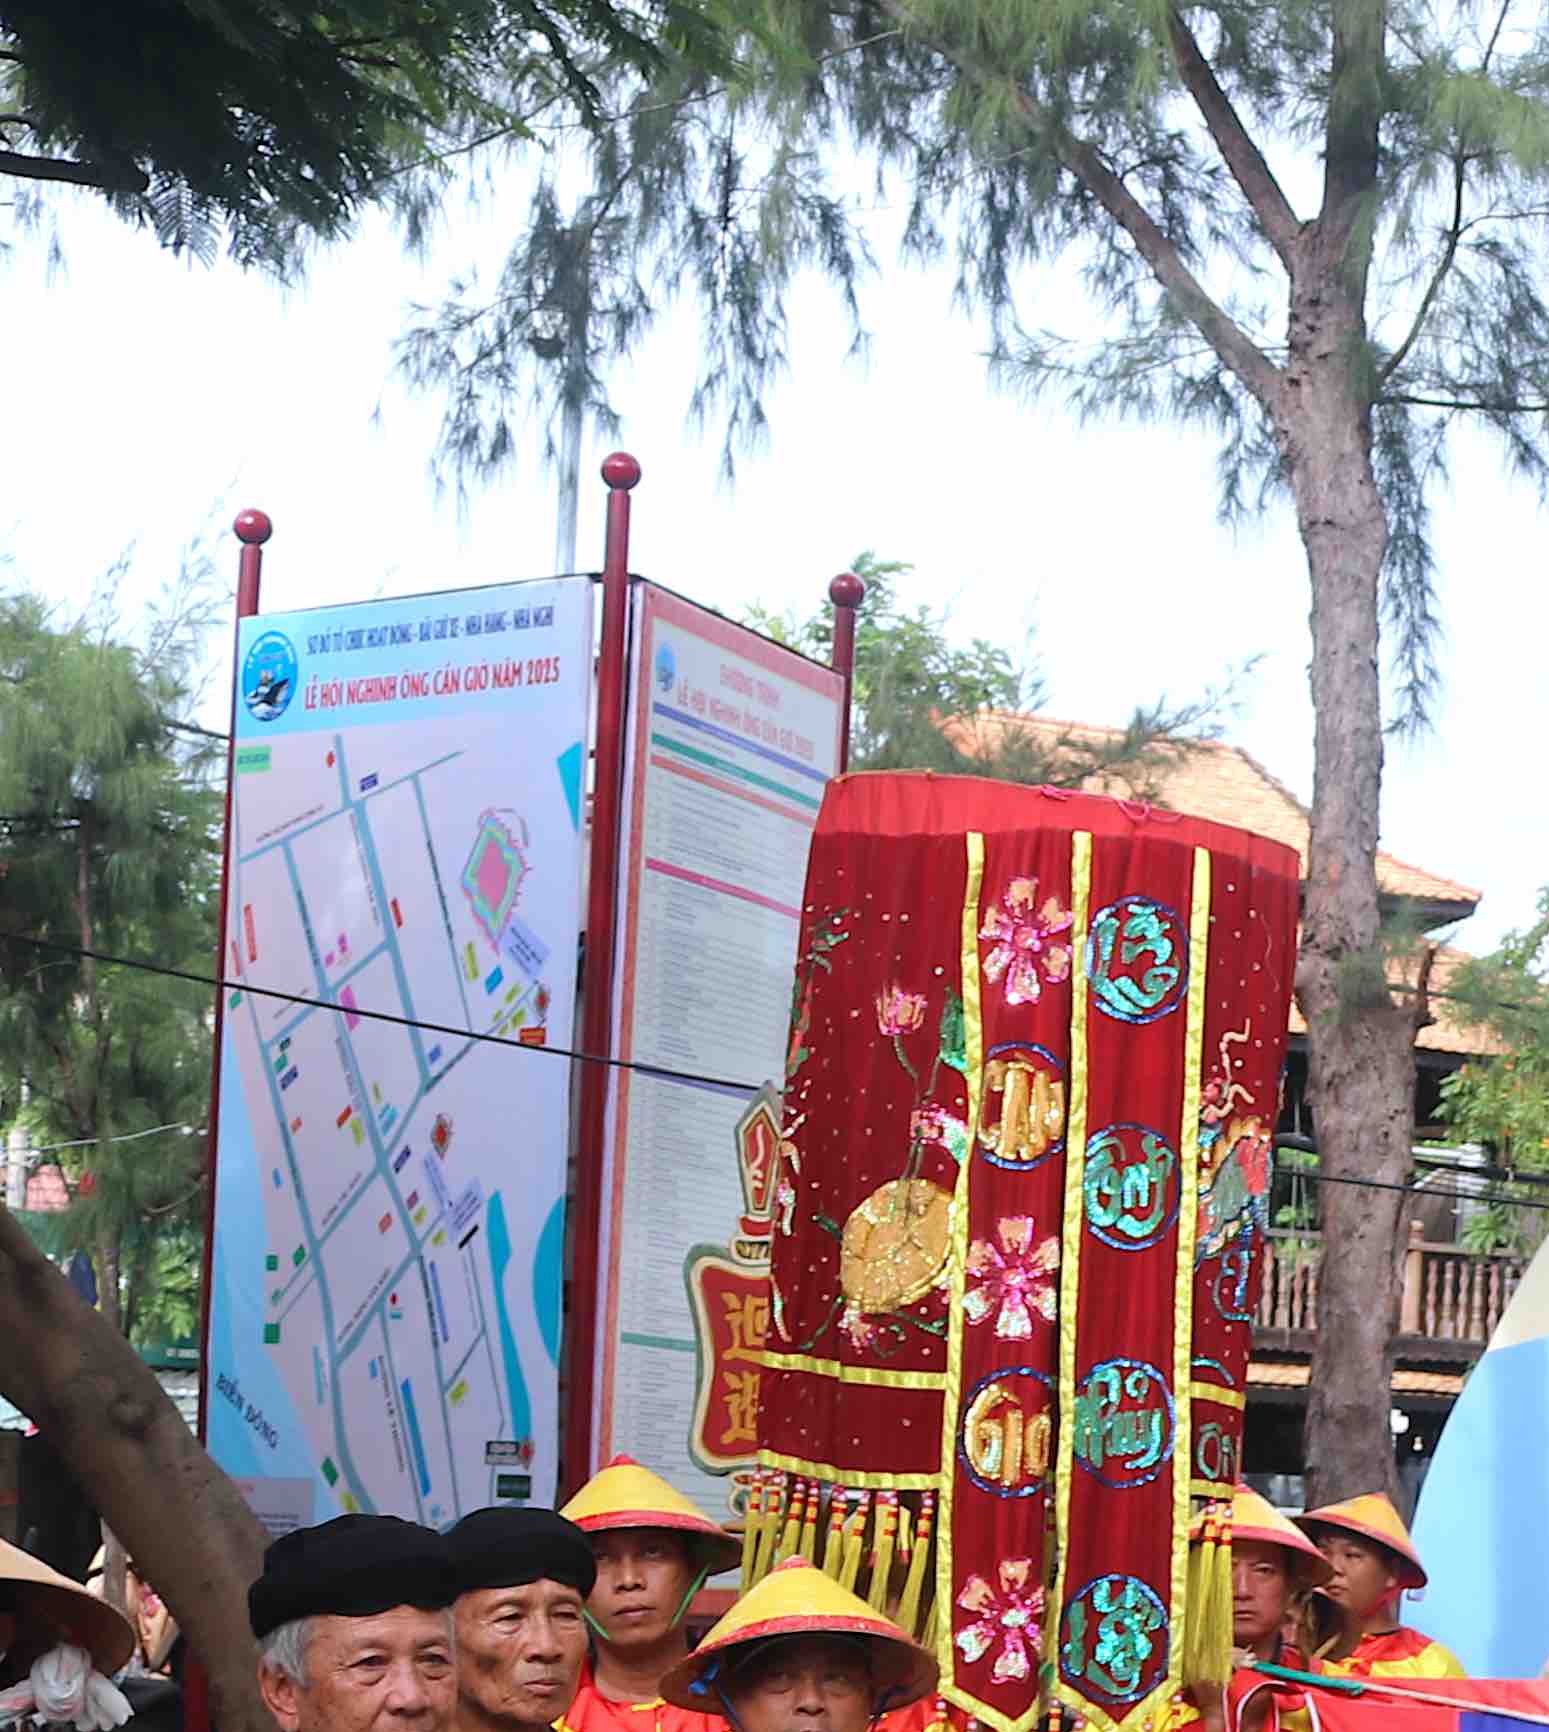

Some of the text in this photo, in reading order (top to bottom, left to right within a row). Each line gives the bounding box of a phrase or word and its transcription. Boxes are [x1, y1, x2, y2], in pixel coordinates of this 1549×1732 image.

[320, 678, 344, 712] HỘI
[347, 675, 397, 705] NGHINH
[400, 669, 430, 699] ÔNG
[433, 660, 461, 695] CẦN
[464, 658, 489, 692] GIỜ
[492, 656, 523, 689] NĂM
[527, 655, 560, 685] 2025
